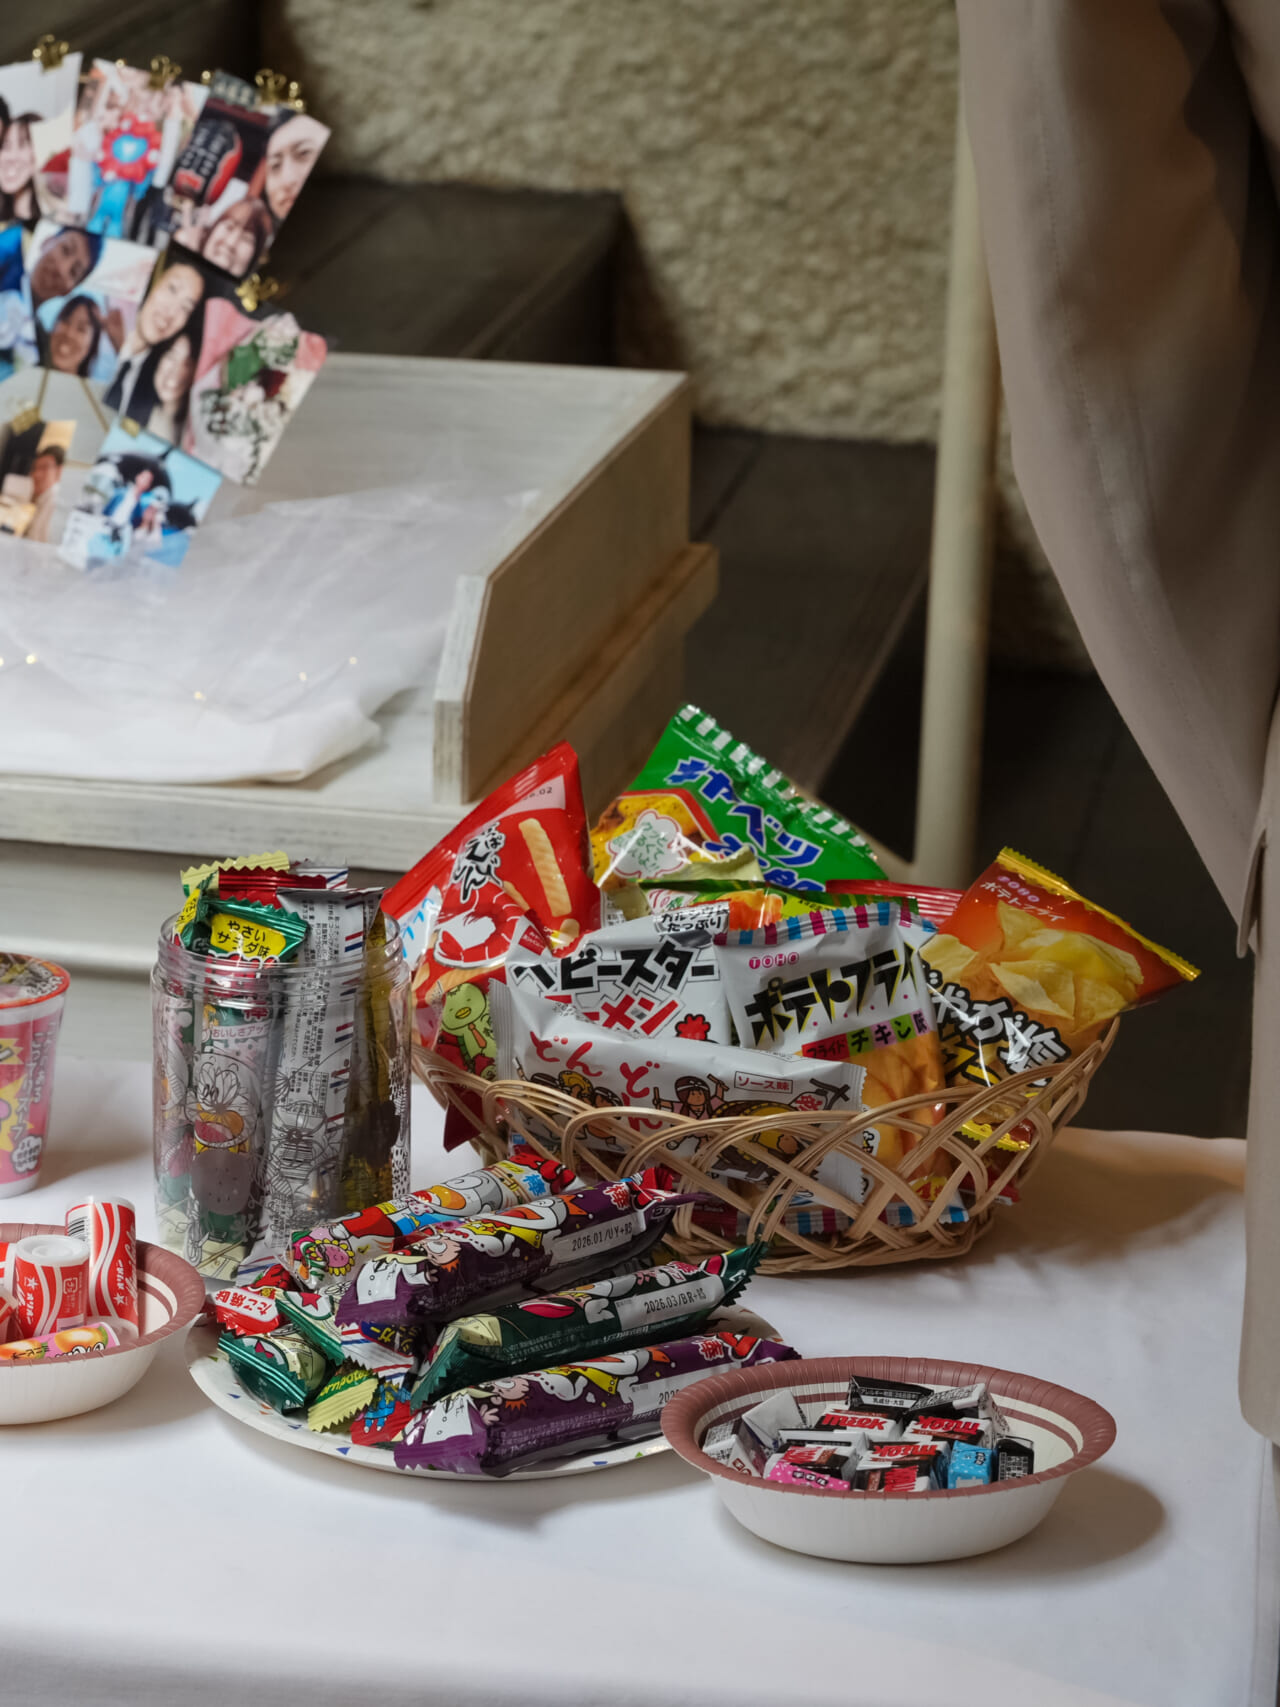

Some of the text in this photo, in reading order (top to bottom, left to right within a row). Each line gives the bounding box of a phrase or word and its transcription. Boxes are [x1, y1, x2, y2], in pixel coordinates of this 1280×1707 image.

[665, 756, 824, 867] キャベツ
[980, 881, 1066, 922] ポテトフライ
[227, 920, 266, 942] やさい
[667, 916, 722, 932] たっぷり
[217, 931, 271, 958] サラダ味
[748, 951, 800, 970] TOHO
[744, 941, 919, 1047] ポテトフライ
[737, 1075, 790, 1091] ソース味
[214, 1289, 273, 1317] たこ焼味
